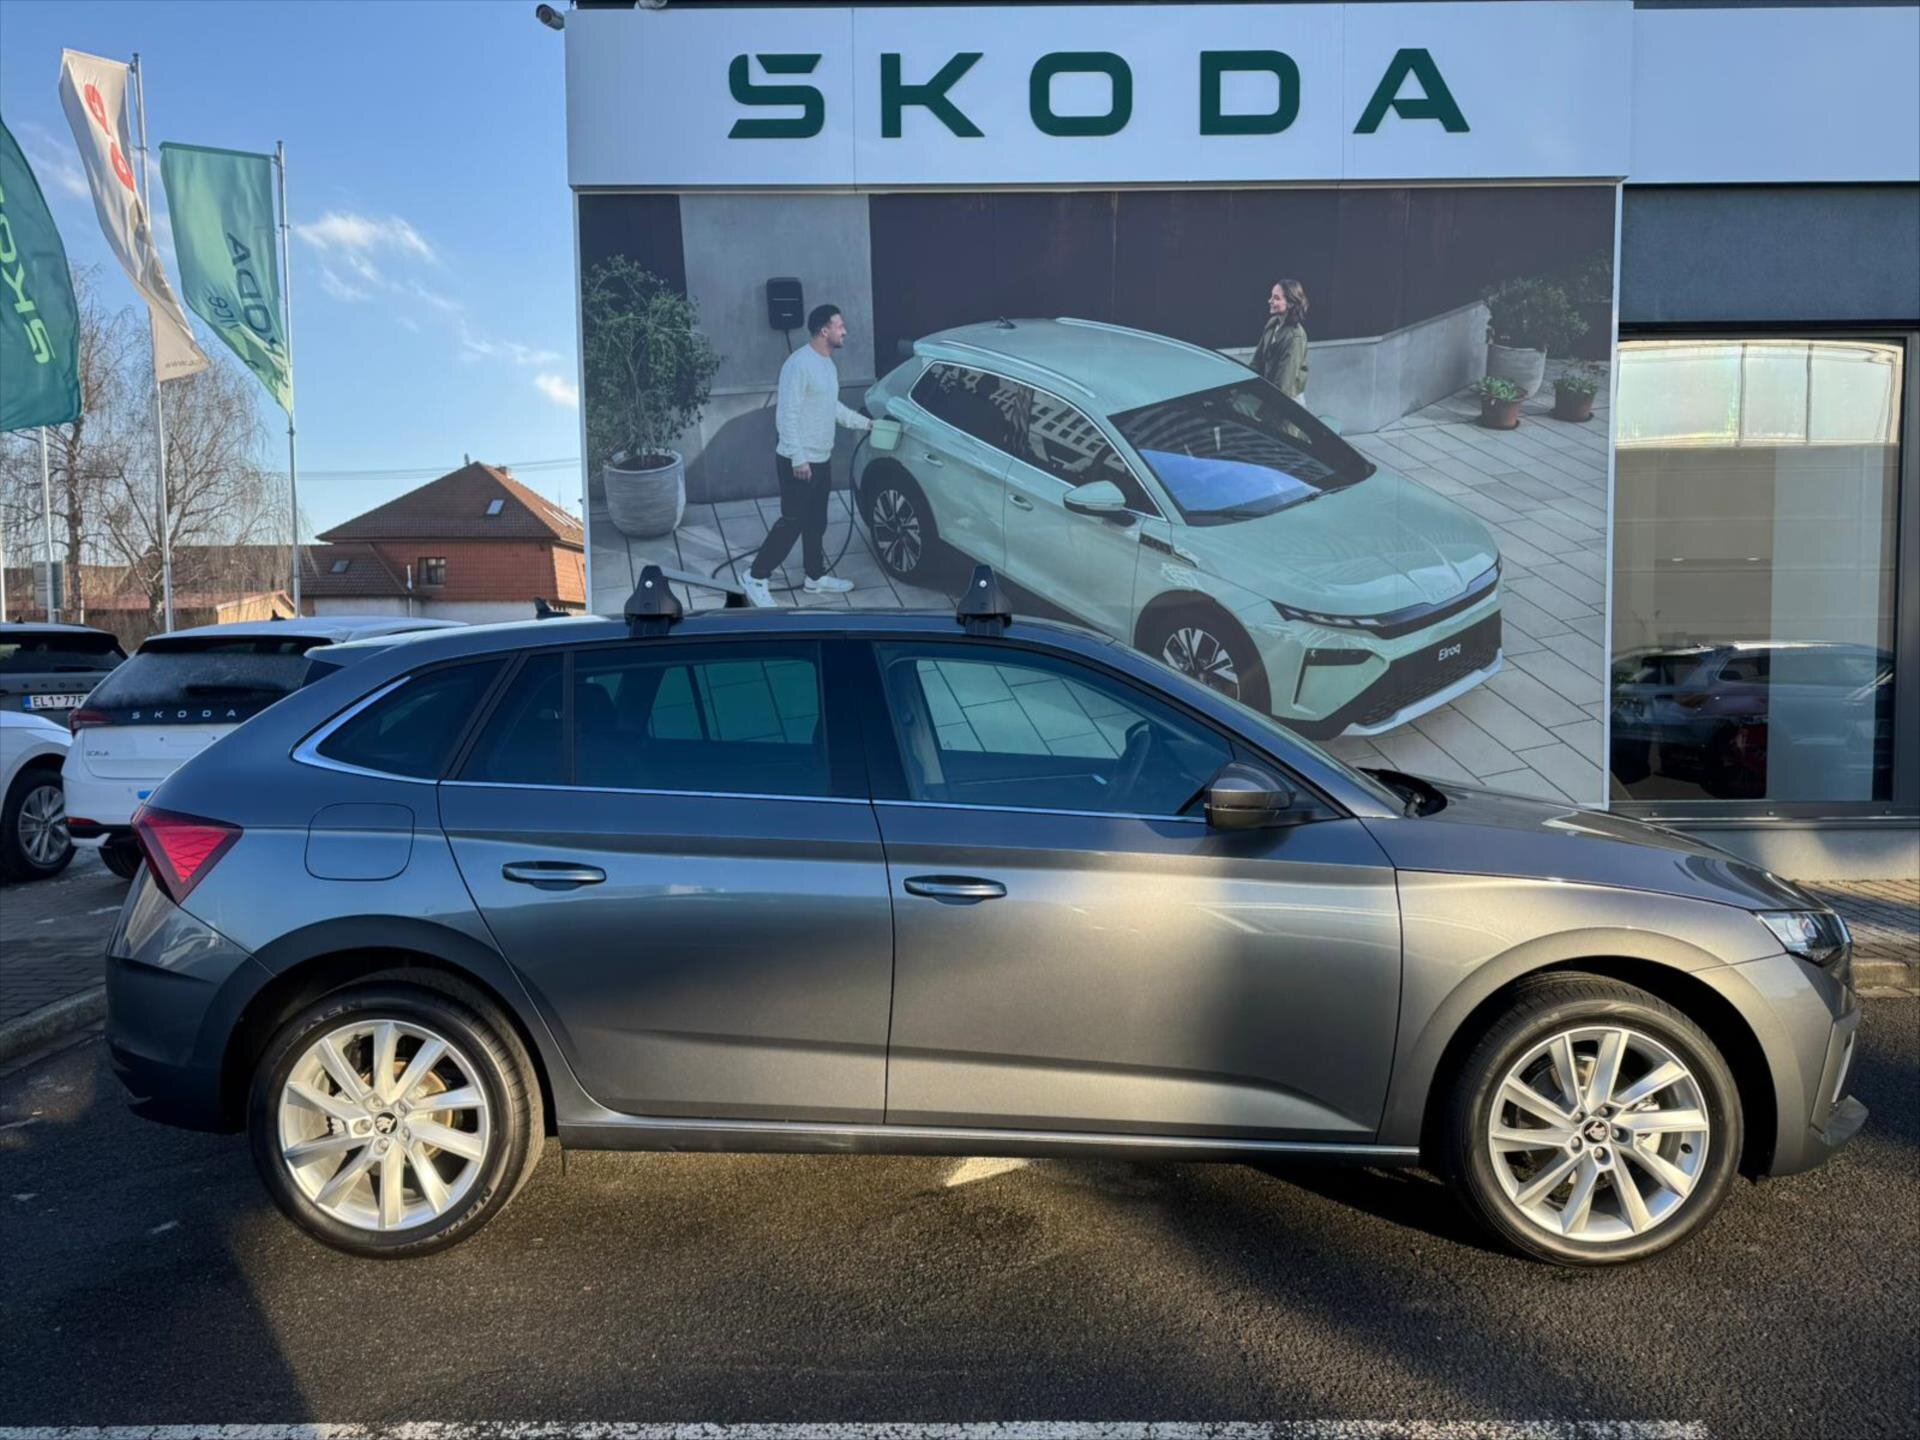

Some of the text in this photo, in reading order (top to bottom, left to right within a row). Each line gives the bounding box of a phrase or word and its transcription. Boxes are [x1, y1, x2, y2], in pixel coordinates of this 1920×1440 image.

[728, 47, 1471, 139] SKODA
[0, 184, 56, 364] SKO
[131, 709, 236, 720] SKODA
